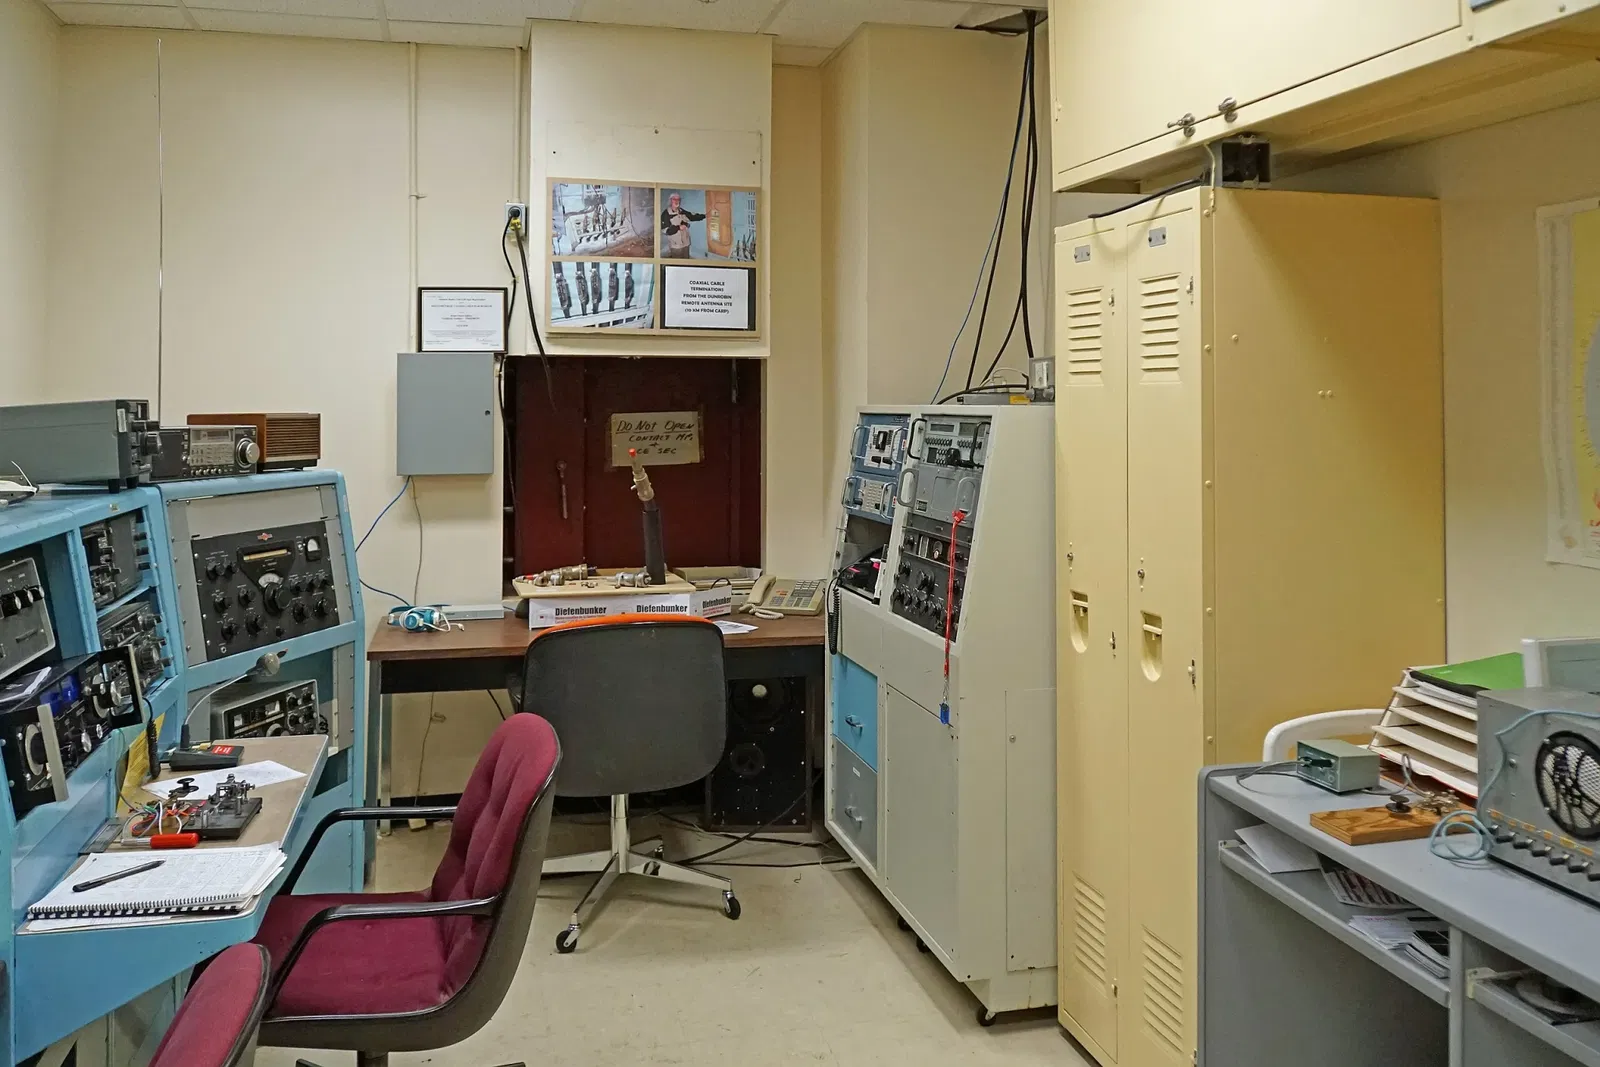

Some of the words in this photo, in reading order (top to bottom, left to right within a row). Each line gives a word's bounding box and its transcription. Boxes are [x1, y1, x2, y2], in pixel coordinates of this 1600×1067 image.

[702, 597, 732, 608] Diefenbunker
[555, 606, 607, 616] Diefenbunker
[636, 605, 687, 613] Diefenbunker
